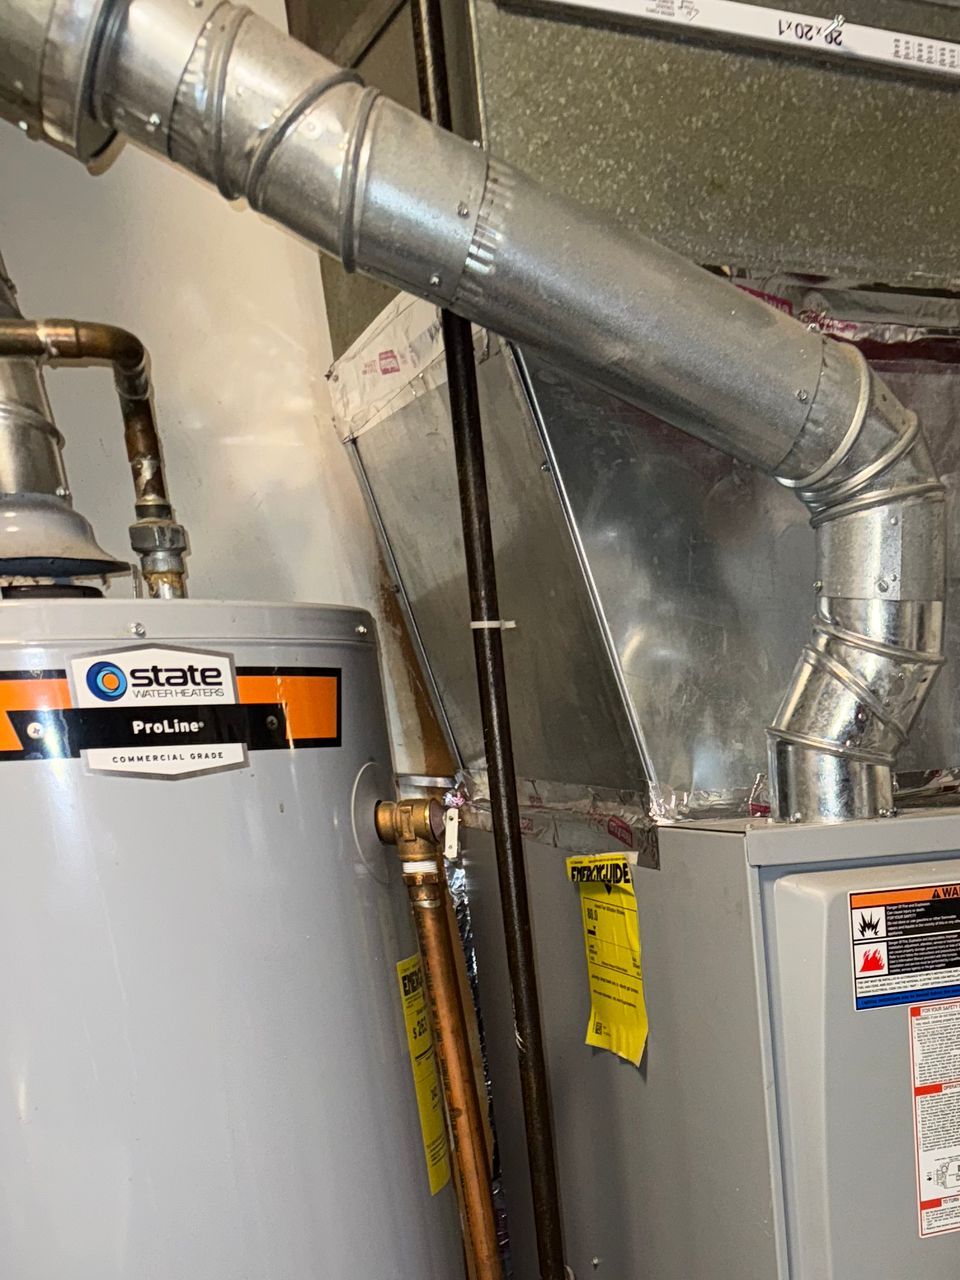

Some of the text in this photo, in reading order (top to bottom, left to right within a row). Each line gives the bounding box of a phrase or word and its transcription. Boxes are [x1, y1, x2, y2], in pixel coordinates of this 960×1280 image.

[778, 19, 785, 36] 1
[795, 22, 814, 41] 20
[130, 664, 222, 689] state
[132, 687, 225, 699] WATER HEATERS
[112, 751, 224, 764] COMMERCIAL GRADE
